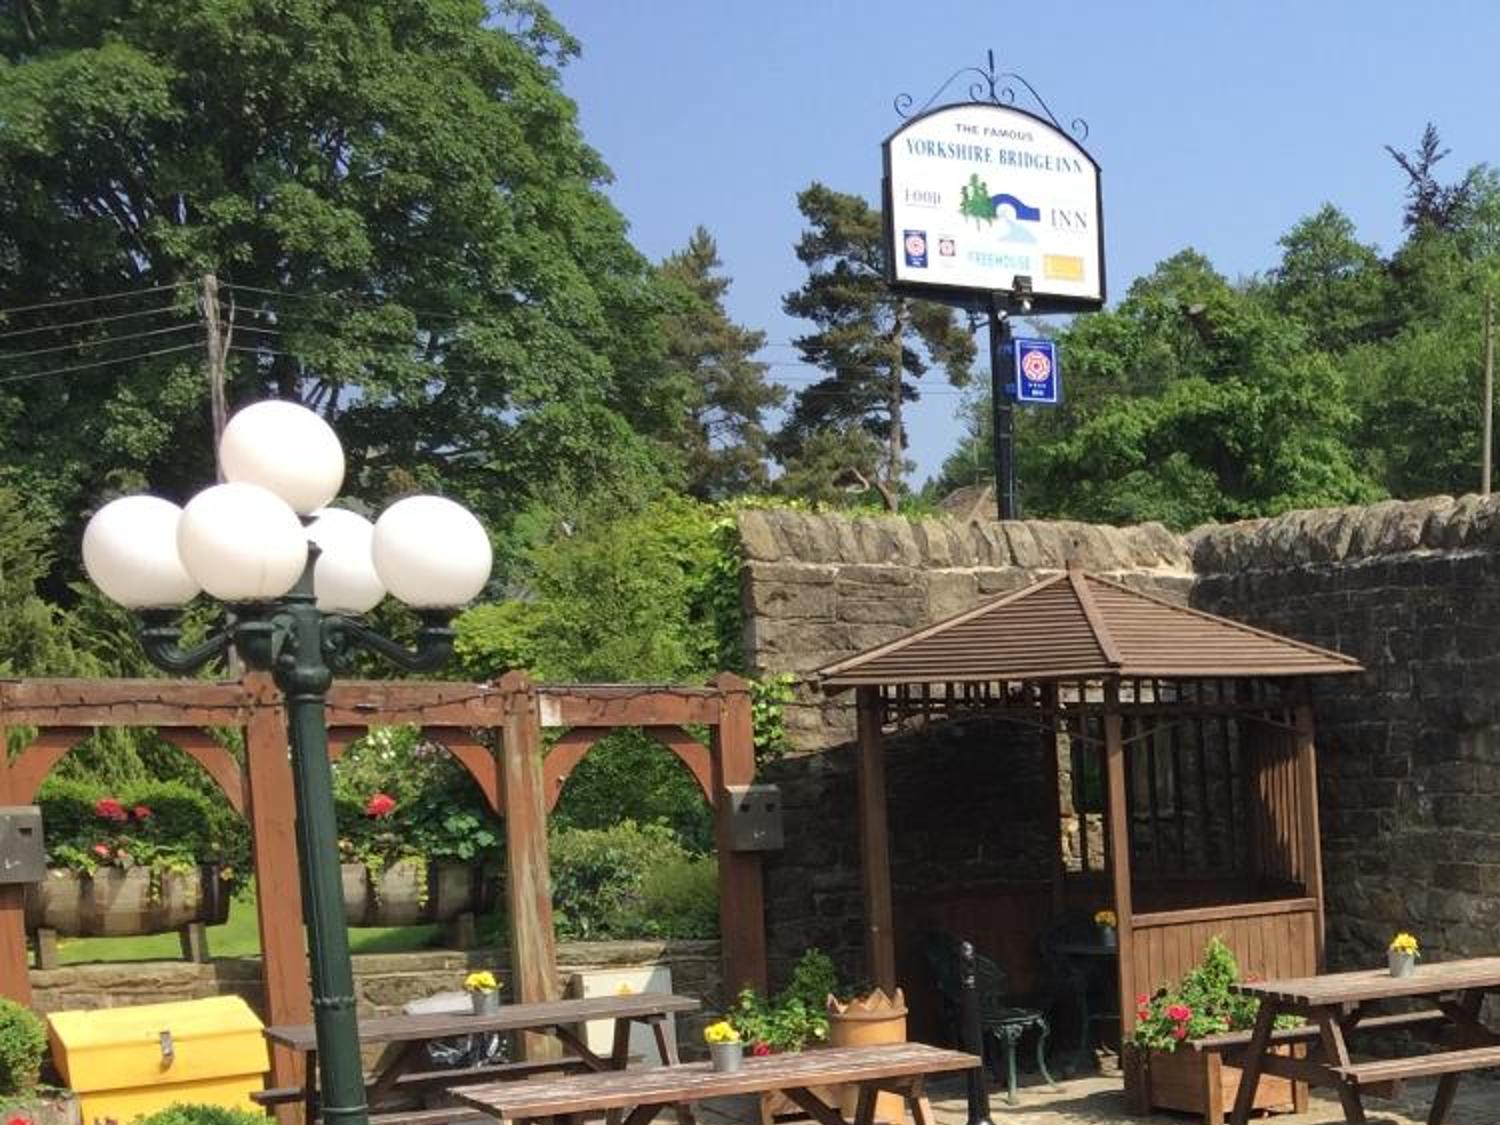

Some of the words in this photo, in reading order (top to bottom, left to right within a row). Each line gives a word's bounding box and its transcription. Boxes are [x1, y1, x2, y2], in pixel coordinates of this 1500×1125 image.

[955, 123, 979, 135] THE
[983, 126, 1034, 141] FAMOUS
[906, 137, 992, 163] YORKSHIRE
[999, 148, 1054, 171] BRIDGE
[1051, 207, 1087, 229] INN
